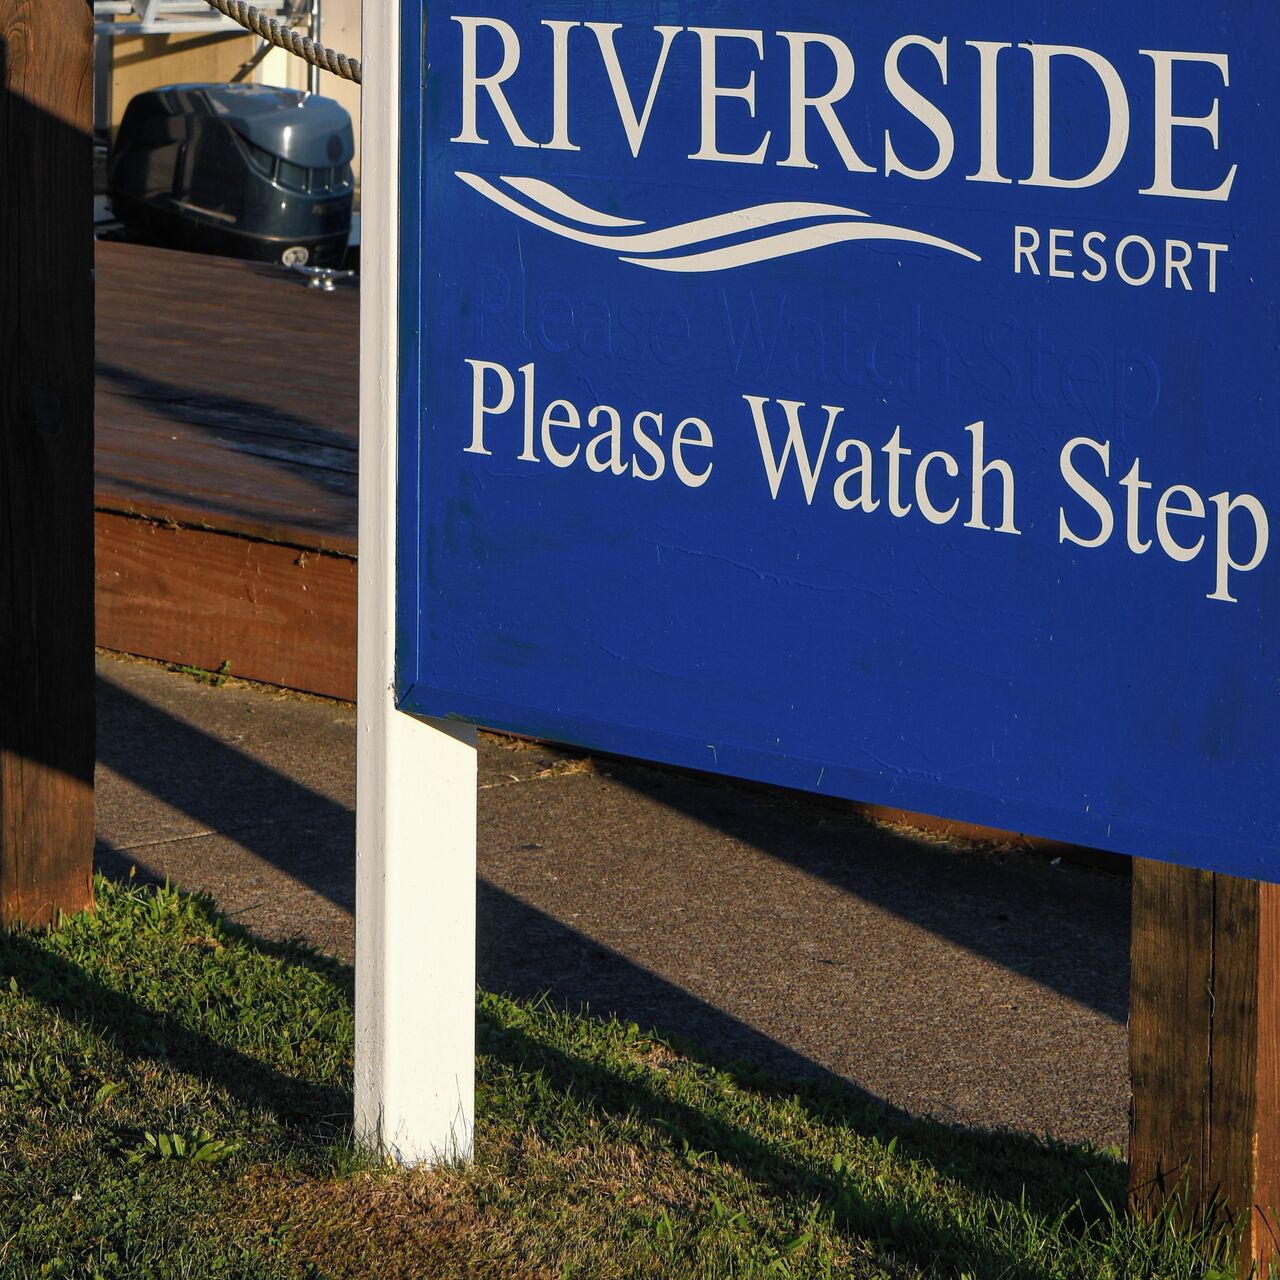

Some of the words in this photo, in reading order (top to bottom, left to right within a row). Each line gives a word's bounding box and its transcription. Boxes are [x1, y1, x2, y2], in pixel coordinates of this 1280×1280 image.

[449, 15, 1238, 202] RIVERSIDE
[1014, 225, 1230, 293] RESORT
[463, 358, 714, 488] Please
[742, 394, 1022, 535] Watch
[1059, 436, 1269, 603] Step
